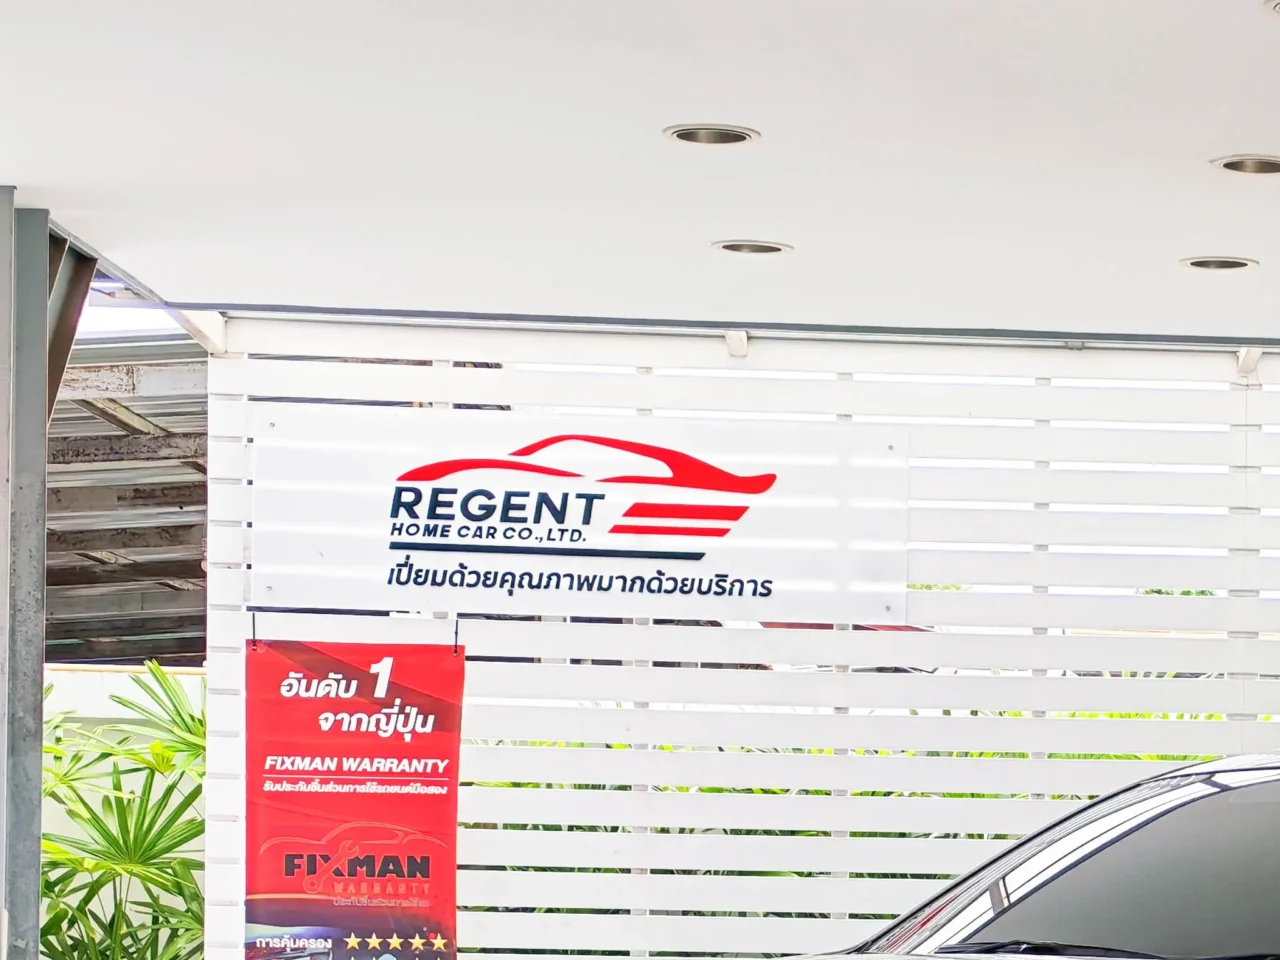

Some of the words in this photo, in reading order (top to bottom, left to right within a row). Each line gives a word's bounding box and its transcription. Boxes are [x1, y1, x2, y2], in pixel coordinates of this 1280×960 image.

[389, 486, 606, 526] REGENT
[390, 523, 452, 538] HOME
[457, 525, 498, 540] CAR
[502, 527, 588, 544] CO.,LTD.
[386, 554, 774, 598] เปี่ยมด้วยคุณภาพมากด้วยบริการ
[279, 671, 359, 699] อันดับ
[369, 656, 394, 699] 1
[318, 698, 435, 742] จากญี่ปุ่น
[263, 755, 337, 772] FIXMAN
[342, 757, 449, 773] WARRANTY
[283, 852, 431, 879] FIXMAN
[255, 935, 332, 953] การคุ้มครอง
